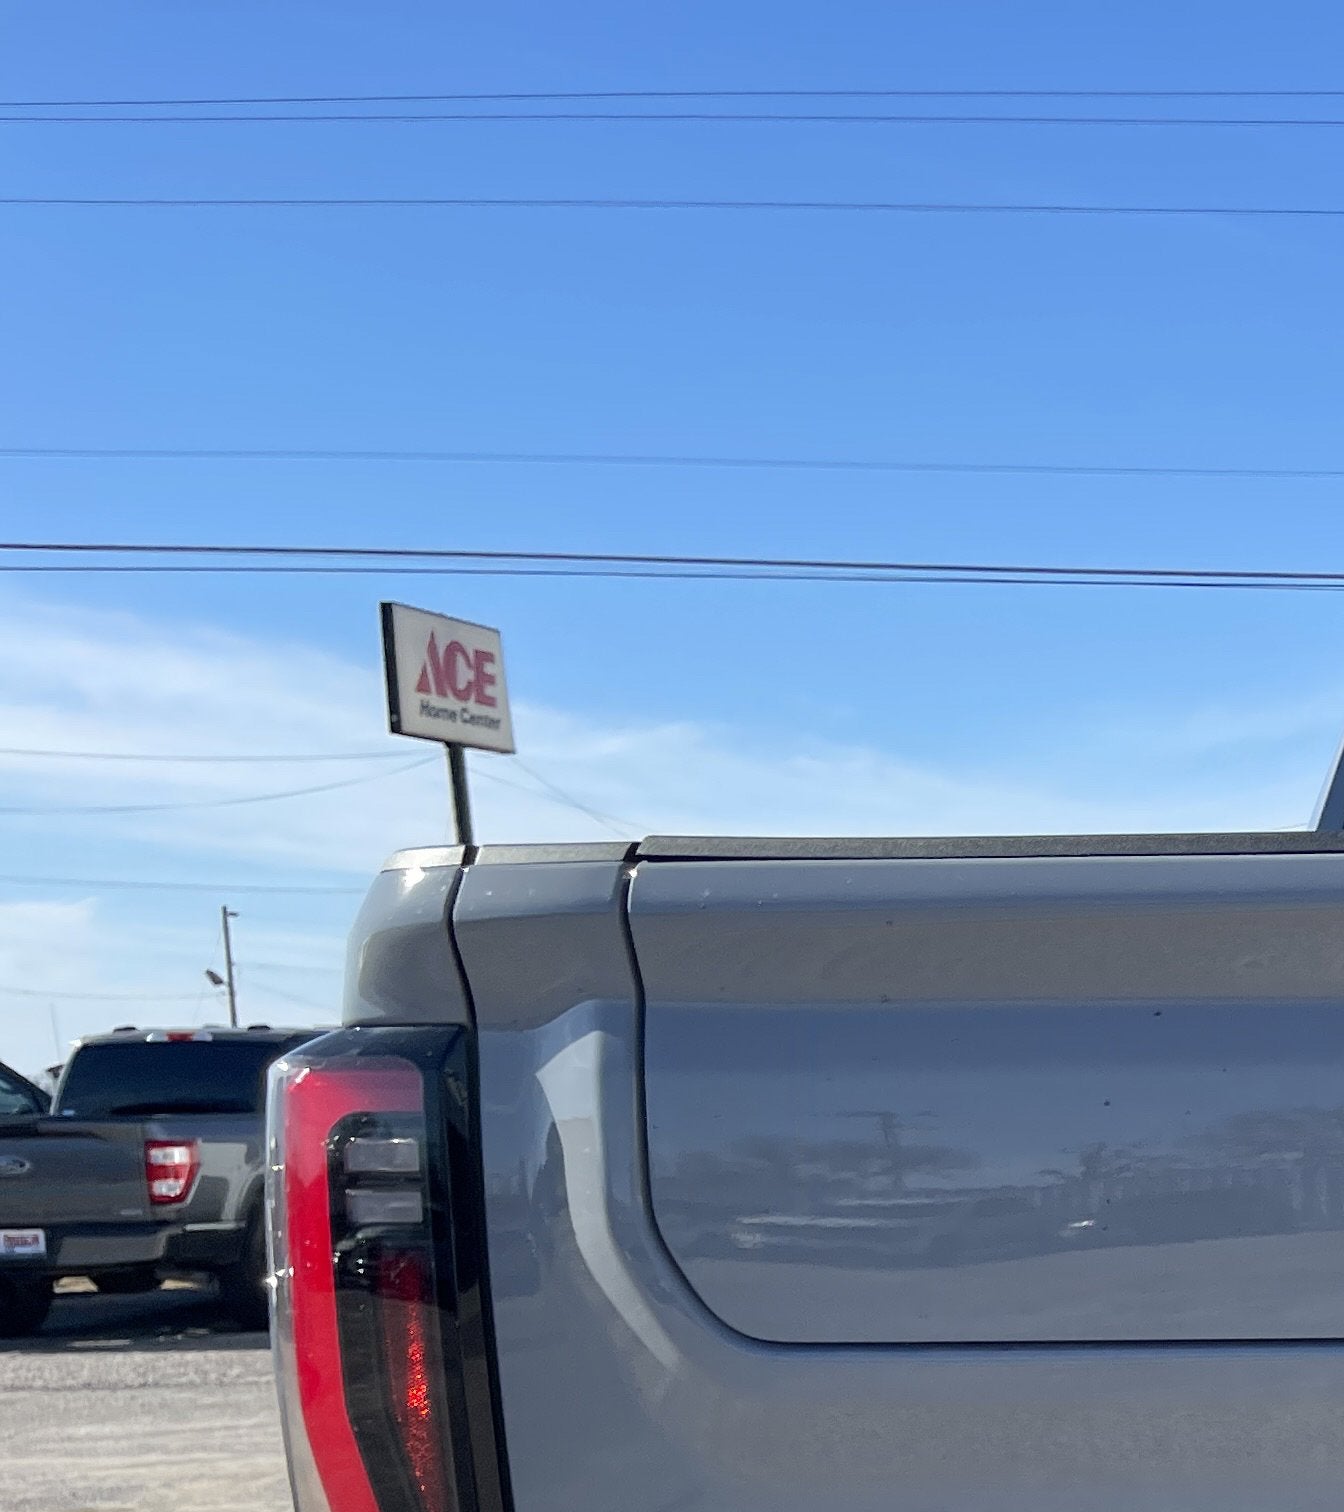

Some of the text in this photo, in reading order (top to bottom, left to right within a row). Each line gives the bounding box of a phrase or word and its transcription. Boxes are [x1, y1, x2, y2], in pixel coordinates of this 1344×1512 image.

[416, 630, 497, 708] ACE
[420, 699, 501, 730] Home Center
